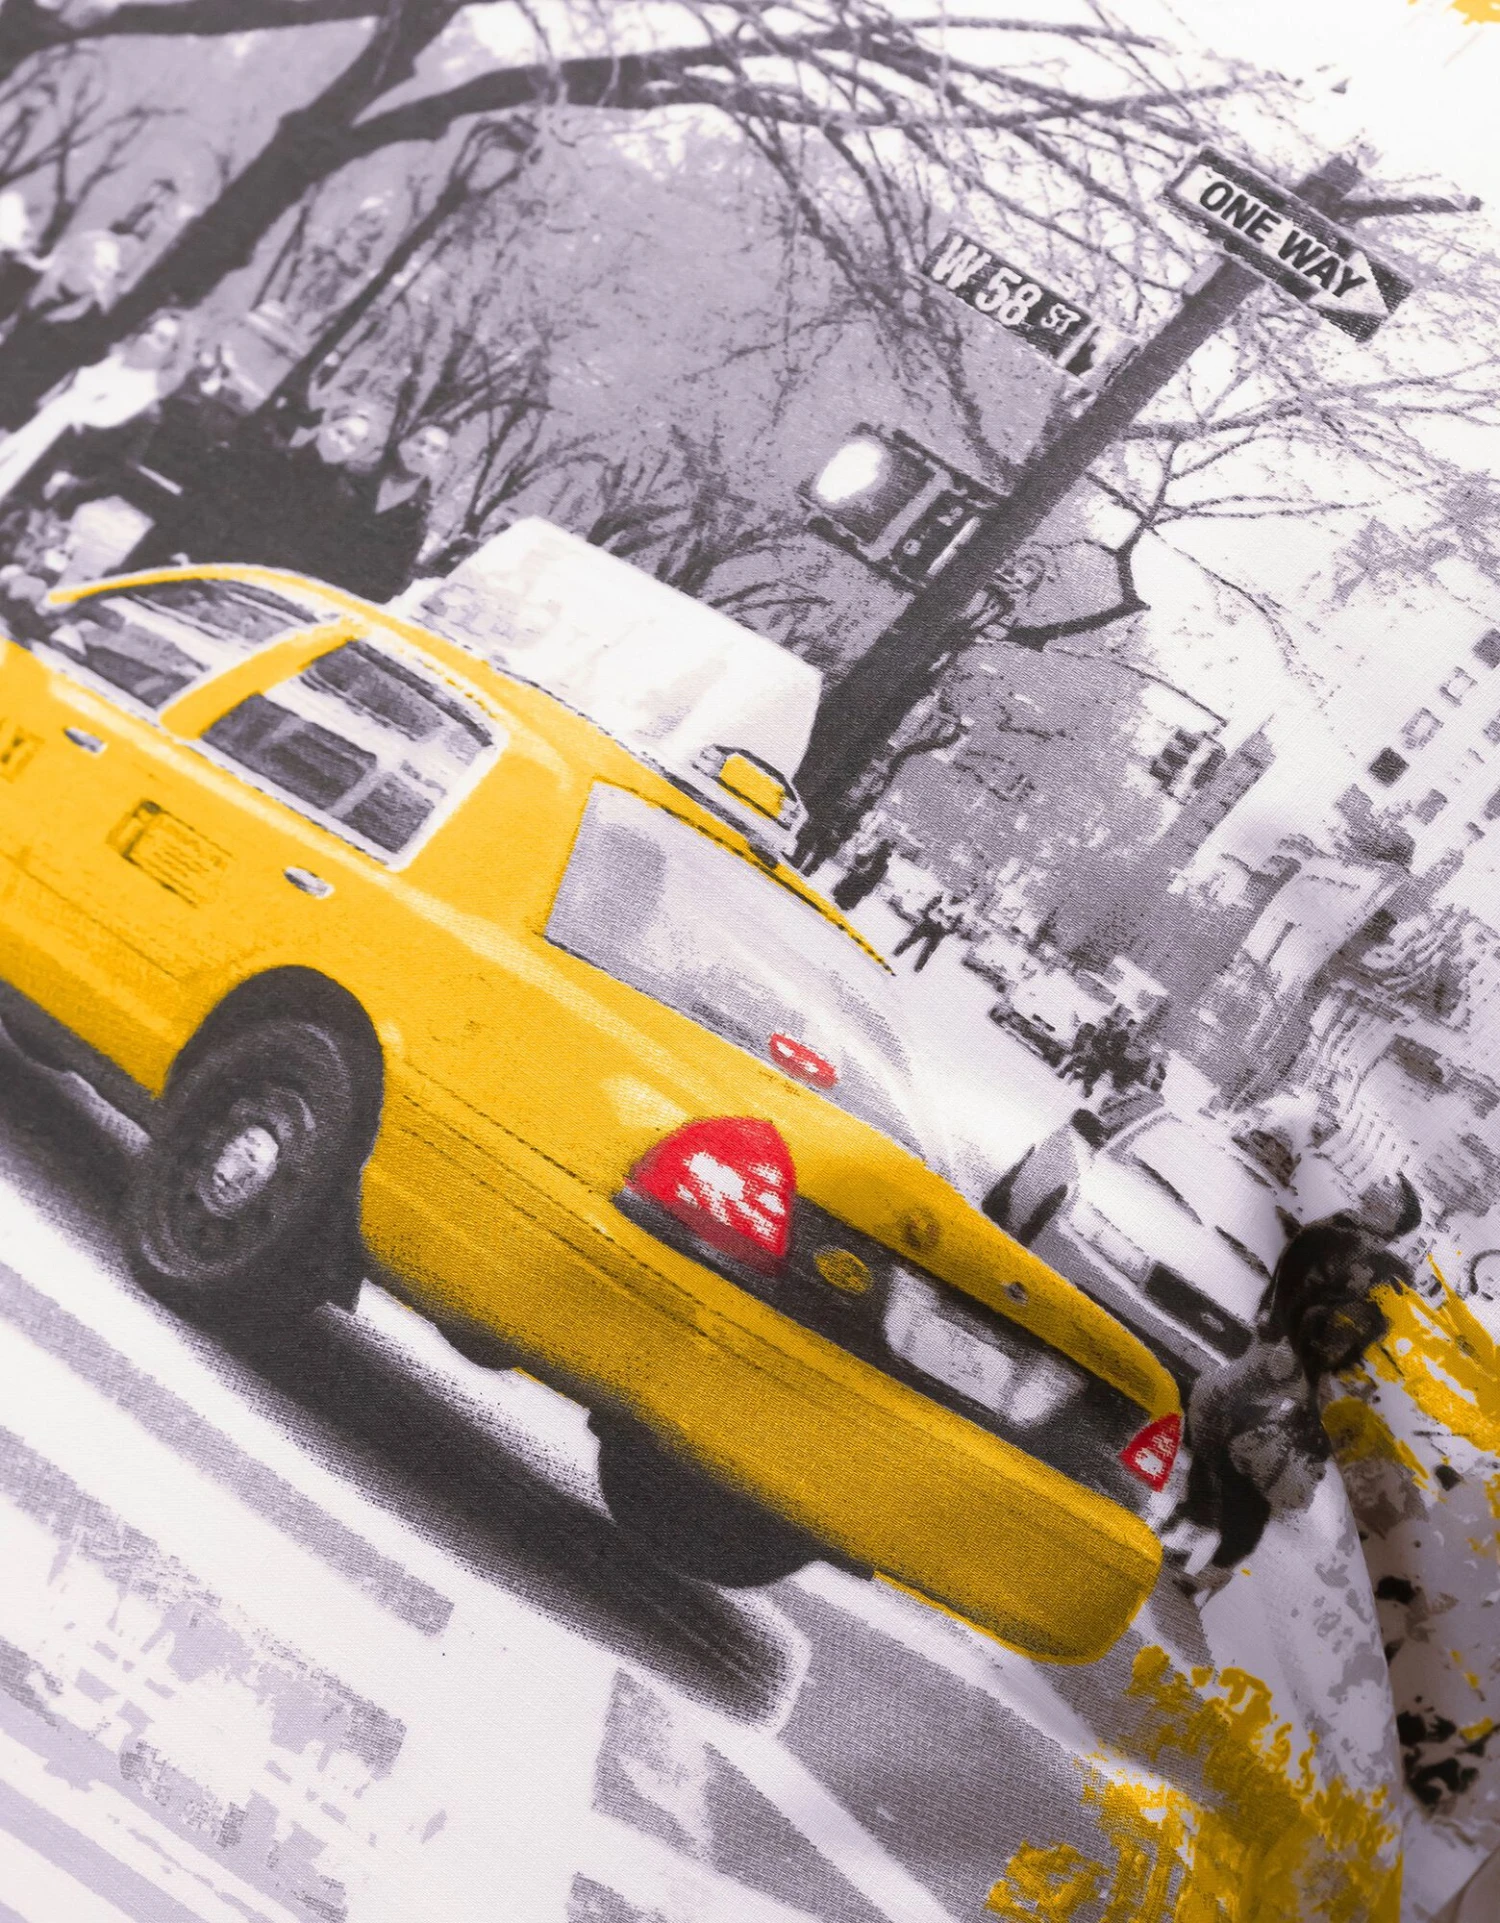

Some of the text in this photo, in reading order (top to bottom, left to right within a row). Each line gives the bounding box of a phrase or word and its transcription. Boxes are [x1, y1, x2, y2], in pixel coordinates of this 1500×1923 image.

[931, 235, 1081, 336] W 58 ST
[1200, 181, 1367, 297] ONE WAY
